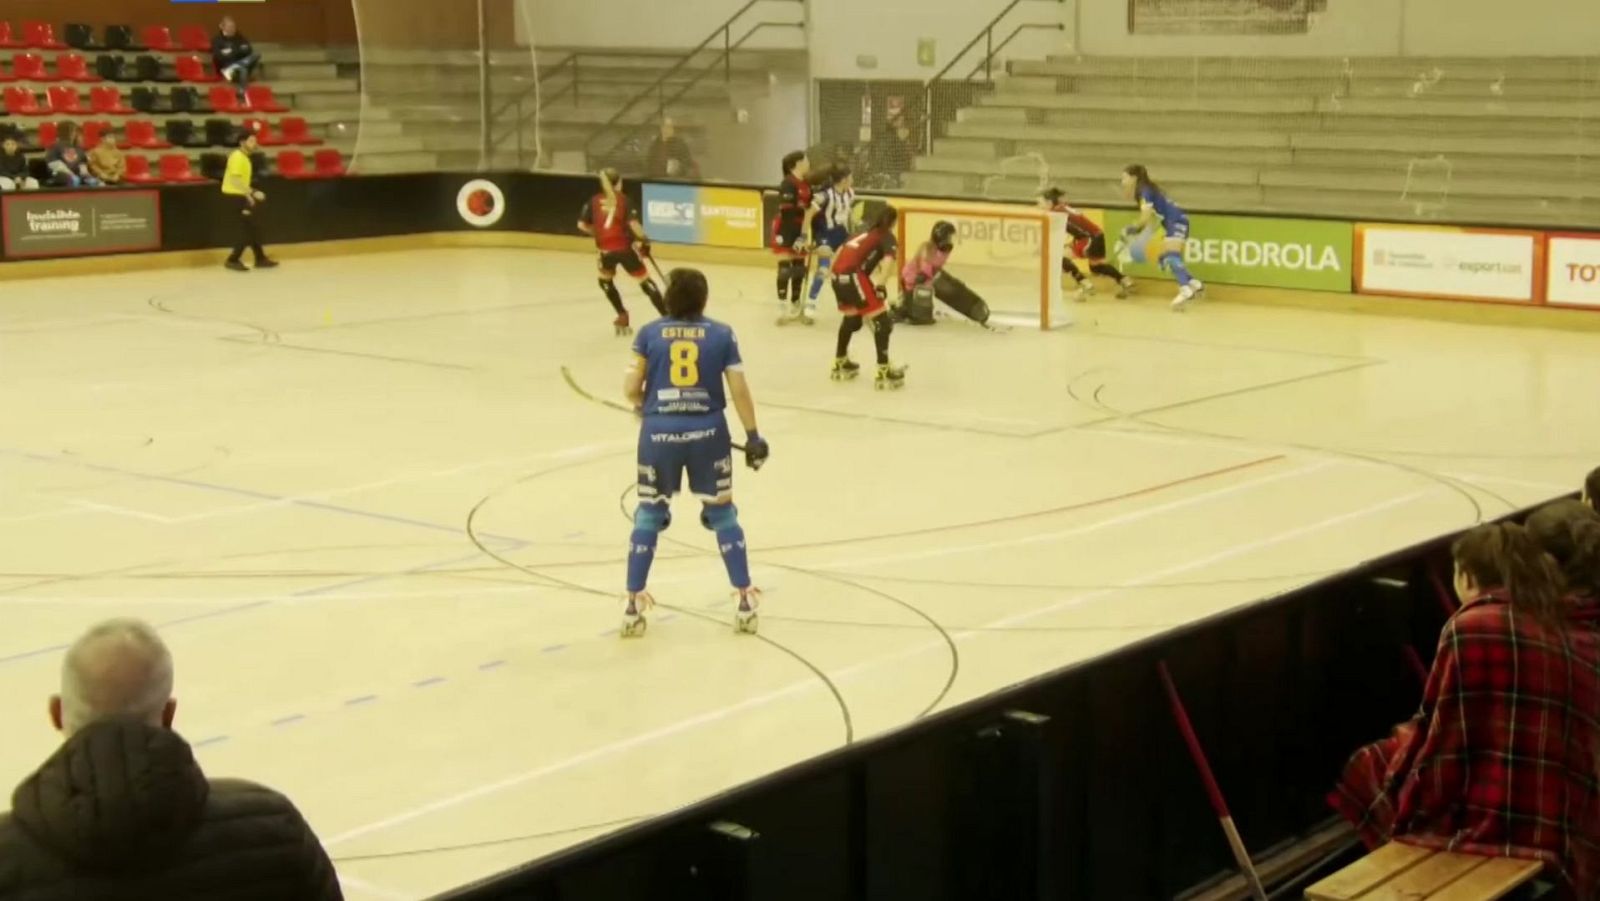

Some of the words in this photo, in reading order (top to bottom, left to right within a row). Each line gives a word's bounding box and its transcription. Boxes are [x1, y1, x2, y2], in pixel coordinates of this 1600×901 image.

[29, 220, 79, 232] training
[1184, 238, 1341, 271] BERDROLA
[661, 327, 705, 338] ESTHER
[669, 339, 699, 387] 8
